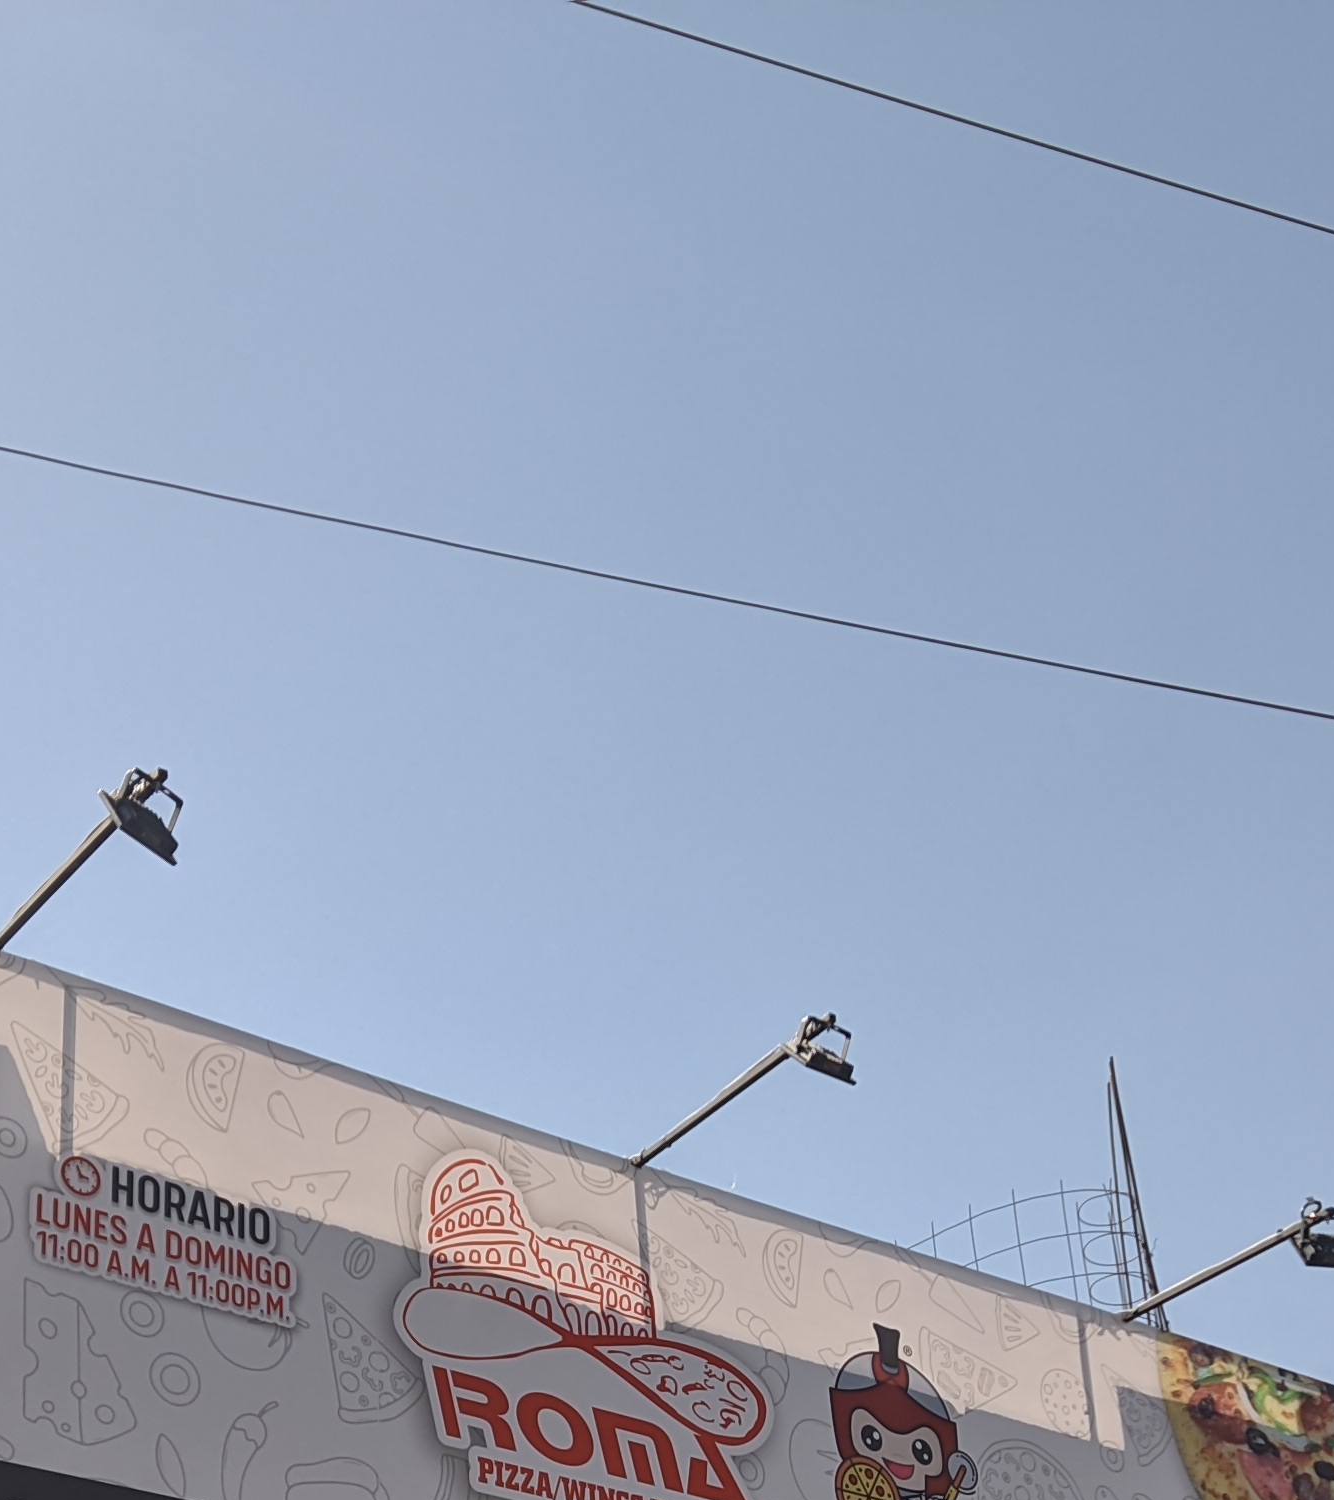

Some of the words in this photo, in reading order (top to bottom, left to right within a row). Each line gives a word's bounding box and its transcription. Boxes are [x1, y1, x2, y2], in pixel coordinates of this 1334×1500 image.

[35, 1193, 128, 1246] LUNES
[136, 1223, 157, 1254] A
[165, 1229, 292, 1291] DOMINGO
[111, 1164, 271, 1246] HORARIO
[36, 1231, 100, 1269] 11:00
[106, 1250, 157, 1286] A.M.
[164, 1266, 181, 1292] A
[187, 1272, 292, 1321] 11:00P.M.
